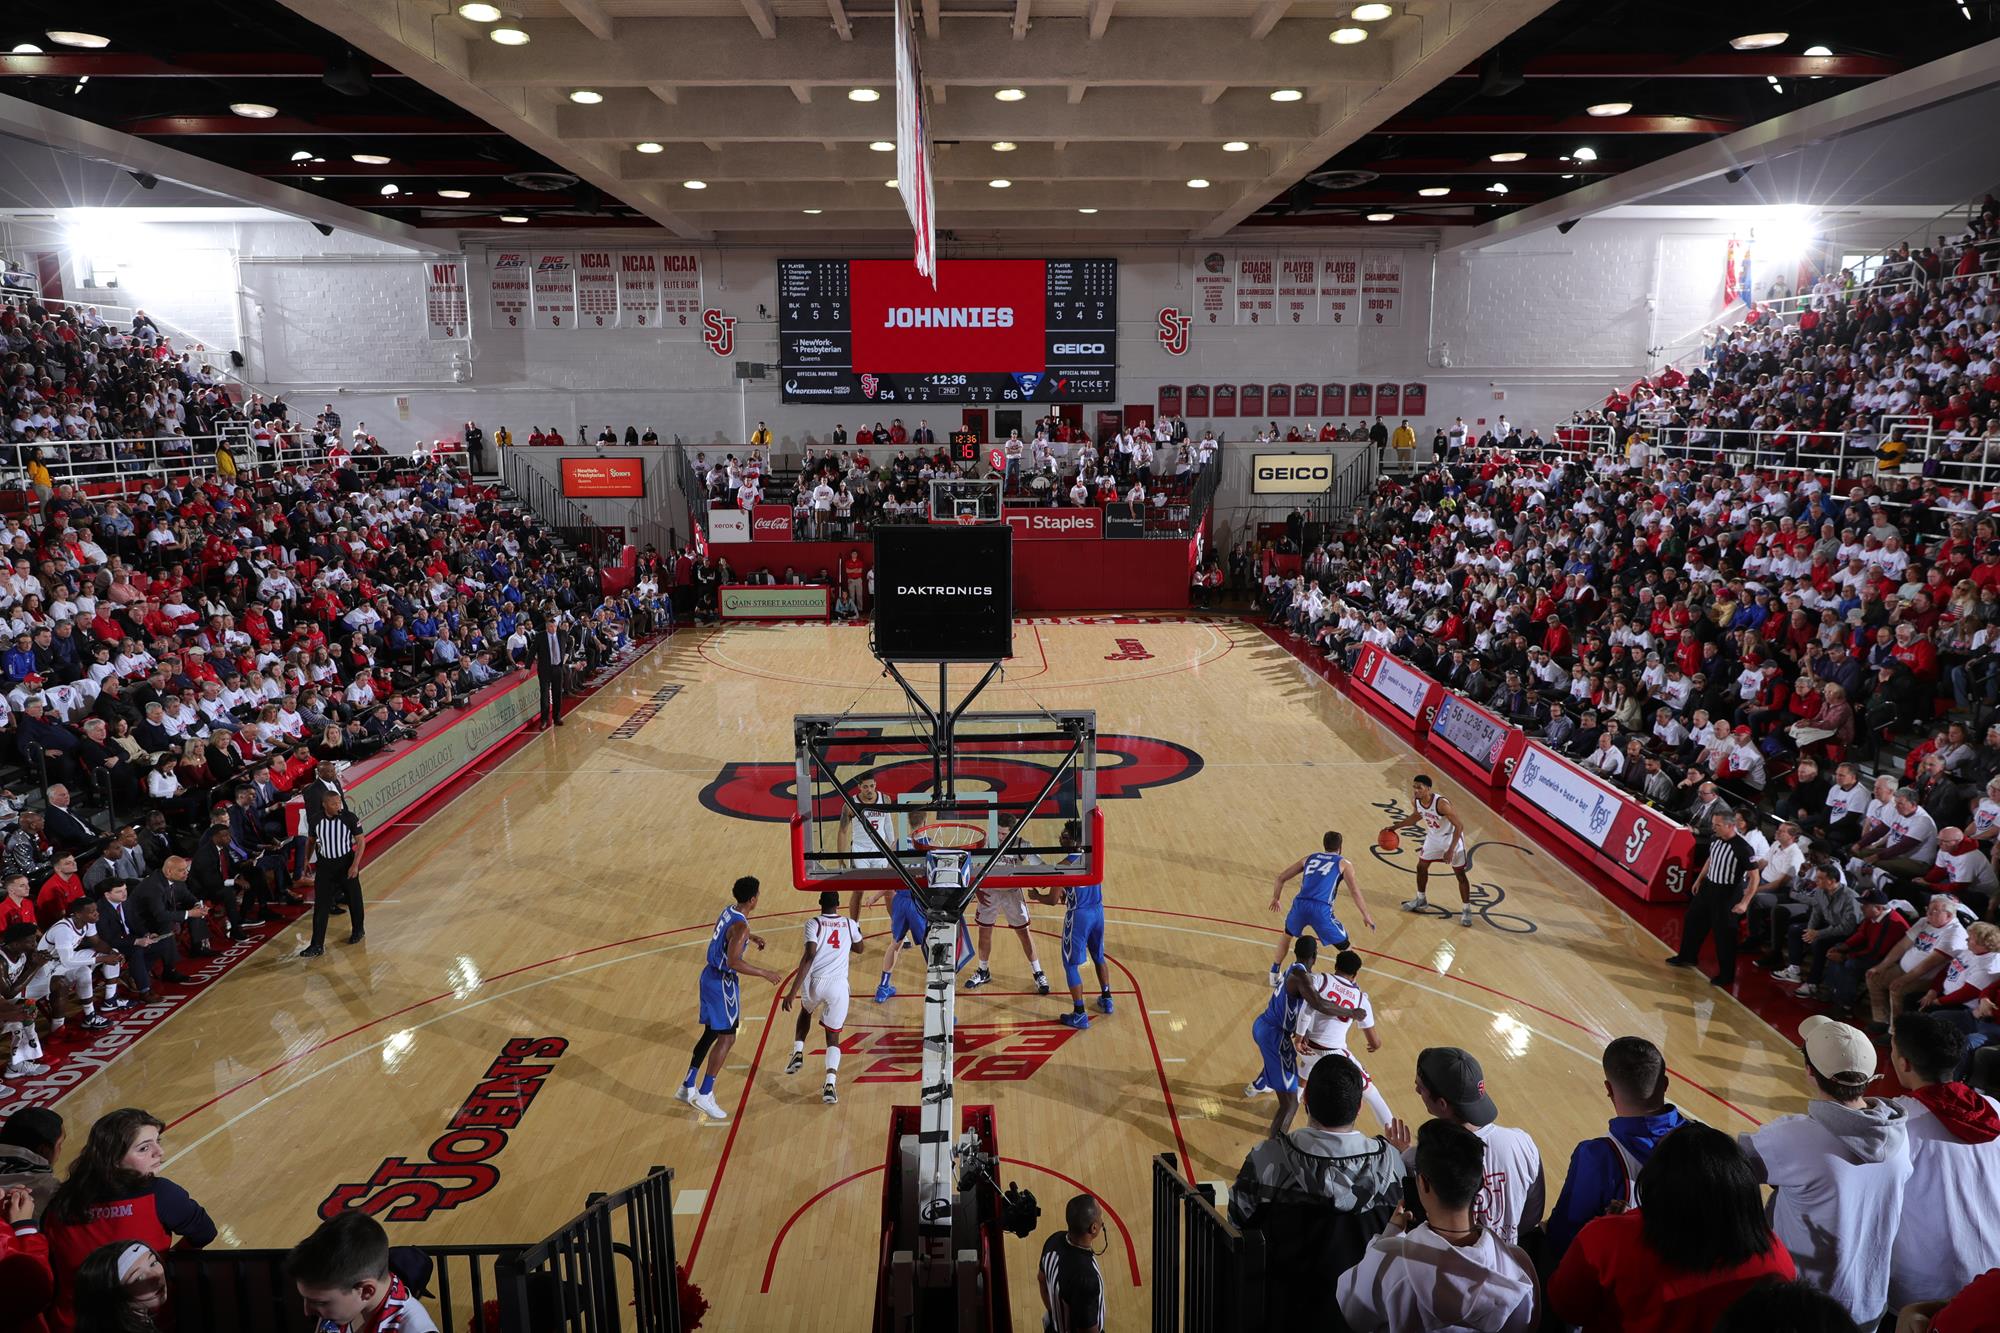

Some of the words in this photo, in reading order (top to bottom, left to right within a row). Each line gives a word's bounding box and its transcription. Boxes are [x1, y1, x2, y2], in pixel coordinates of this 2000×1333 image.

[581, 254, 611, 268] NCAA
[622, 256, 655, 271] NCAA
[664, 255, 697, 271] NCAA
[1241, 262, 1271, 274] COACH
[1283, 262, 1314, 273] PLAYER
[1325, 262, 1356, 273] PLAYER
[433, 265, 456, 283] NIT
[1252, 274, 1271, 284] YEAR
[1294, 273, 1314, 283] YEAR
[1336, 273, 1355, 283] YEAR
[1365, 273, 1399, 281] CHAMPIONS
[492, 282, 529, 290] CHAMPIONS
[535, 285, 573, 293] CHAMPIONS
[626, 282, 644, 290] SWEET
[664, 281, 679, 289] ELITE
[681, 281, 698, 289] EIGHT
[1368, 300, 1392, 309] 1910-11
[791, 311, 798, 320] 4
[813, 311, 819, 320] 5
[833, 311, 840, 320] 5
[884, 307, 1014, 328] JOHNNIES
[1056, 310, 1062, 320] 3
[1077, 310, 1083, 320] 4
[1097, 310, 1103, 320] 5
[800, 346, 842, 355] Presbyterian
[1053, 344, 1105, 354] GEICO
[932, 375, 967, 385] 12:36
[880, 391, 894, 400] 54
[1003, 390, 1018, 399] 56
[955, 435, 977, 443] 12:36
[962, 444, 974, 459] 16
[1258, 467, 1328, 480] GEICO
[1033, 516, 1094, 532] Staples
[897, 586, 992, 595] DAKTRONICS
[471, 724, 489, 742] MAIN
[490, 708, 511, 731] STREET
[511, 688, 540, 716] RADIOLOG
[1451, 705, 1463, 721] 56
[1482, 725, 1495, 742] 54
[1523, 753, 1540, 781] Press
[375, 778, 407, 805] STREET
[408, 744, 453, 788] RADIOLOGY
[1539, 775, 1560, 792] sandwich
[1563, 788, 1575, 803] beer
[1579, 801, 1588, 813] bar
[1591, 794, 1611, 826] Press
[1304, 859, 1334, 876] 24
[713, 920, 724, 940] 5
[827, 930, 841, 949] 4
[179, 933, 266, 986] Queens
[1331, 982, 1356, 1000] FIGUEROA
[87, 1203, 133, 1219] STORM
